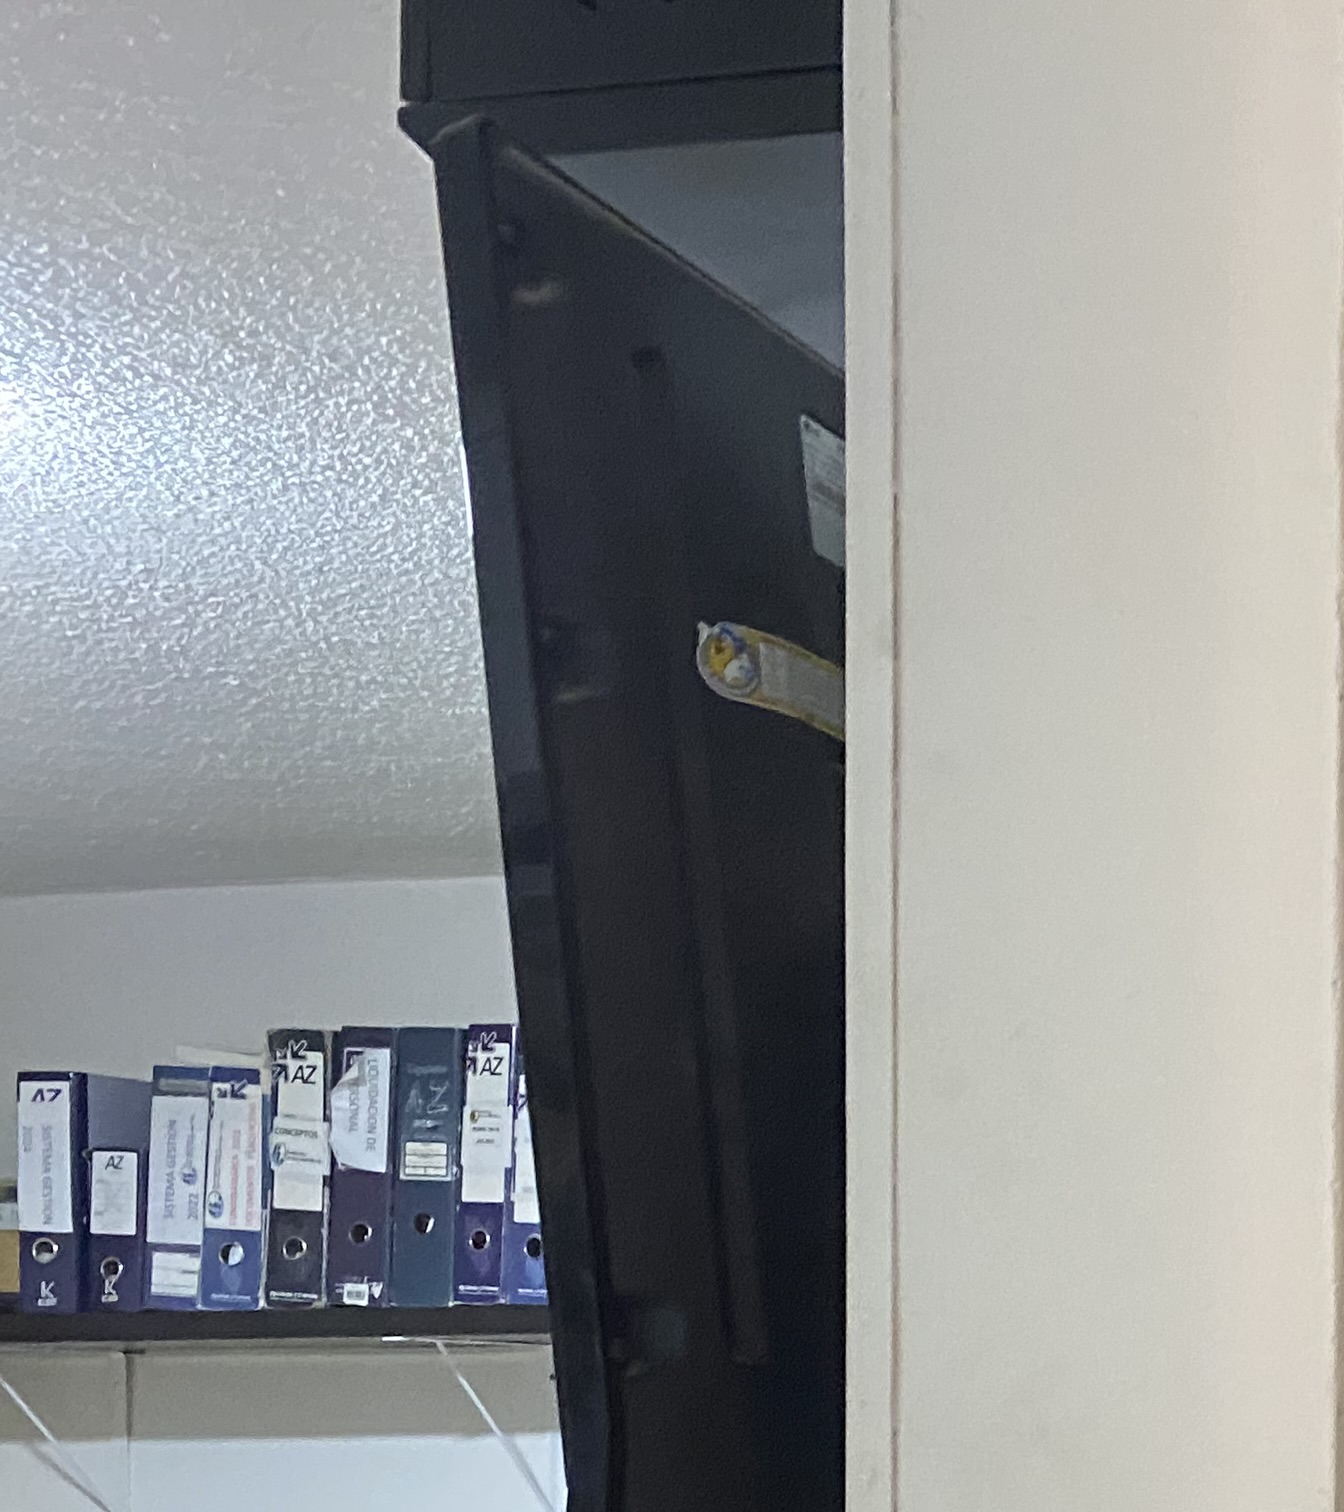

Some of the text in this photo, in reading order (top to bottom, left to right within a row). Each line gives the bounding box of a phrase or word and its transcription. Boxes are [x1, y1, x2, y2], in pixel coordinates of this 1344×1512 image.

[291, 1065, 317, 1084] AZ
[480, 1056, 504, 1076] AZ
[366, 1058, 378, 1152] LIQUIDACION DE
[274, 1127, 318, 1139] CONCEPTOS
[104, 1155, 124, 1170] AZ
[164, 1119, 177, 1219] SISTEMA GESTION
[42, 1125, 53, 1225] SISTEMA GESTION
